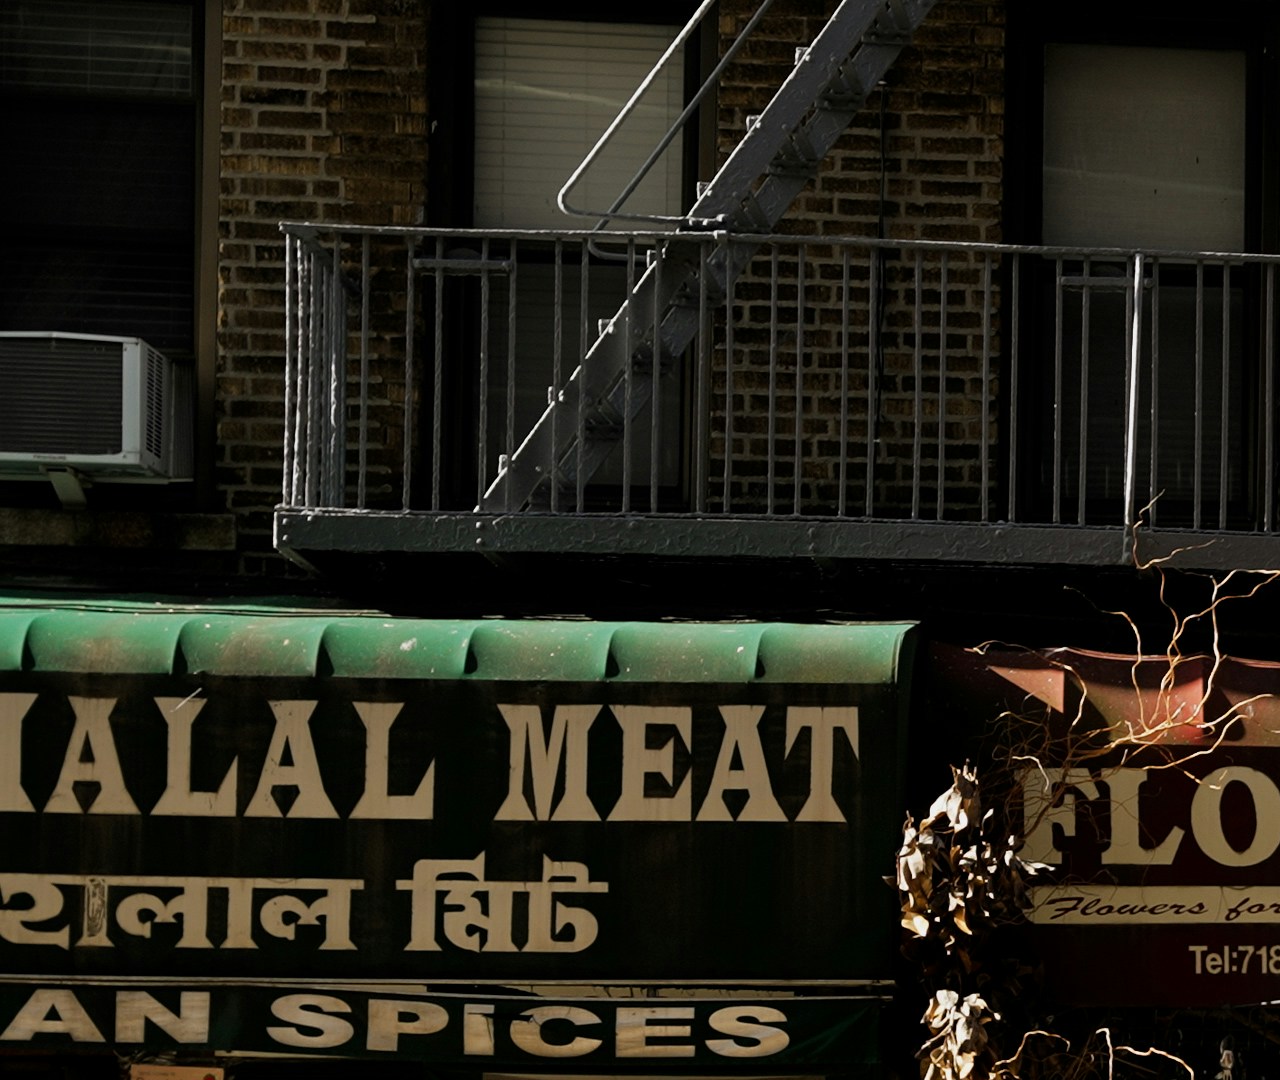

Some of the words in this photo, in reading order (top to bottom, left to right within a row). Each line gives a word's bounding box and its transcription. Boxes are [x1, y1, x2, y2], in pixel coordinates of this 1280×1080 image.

[496, 704, 861, 823] MEAT
[0, 872, 365, 951] হালাল
[395, 851, 609, 954] মিট
[1046, 897, 1209, 920] Flowers
[0, 988, 212, 1044] AN
